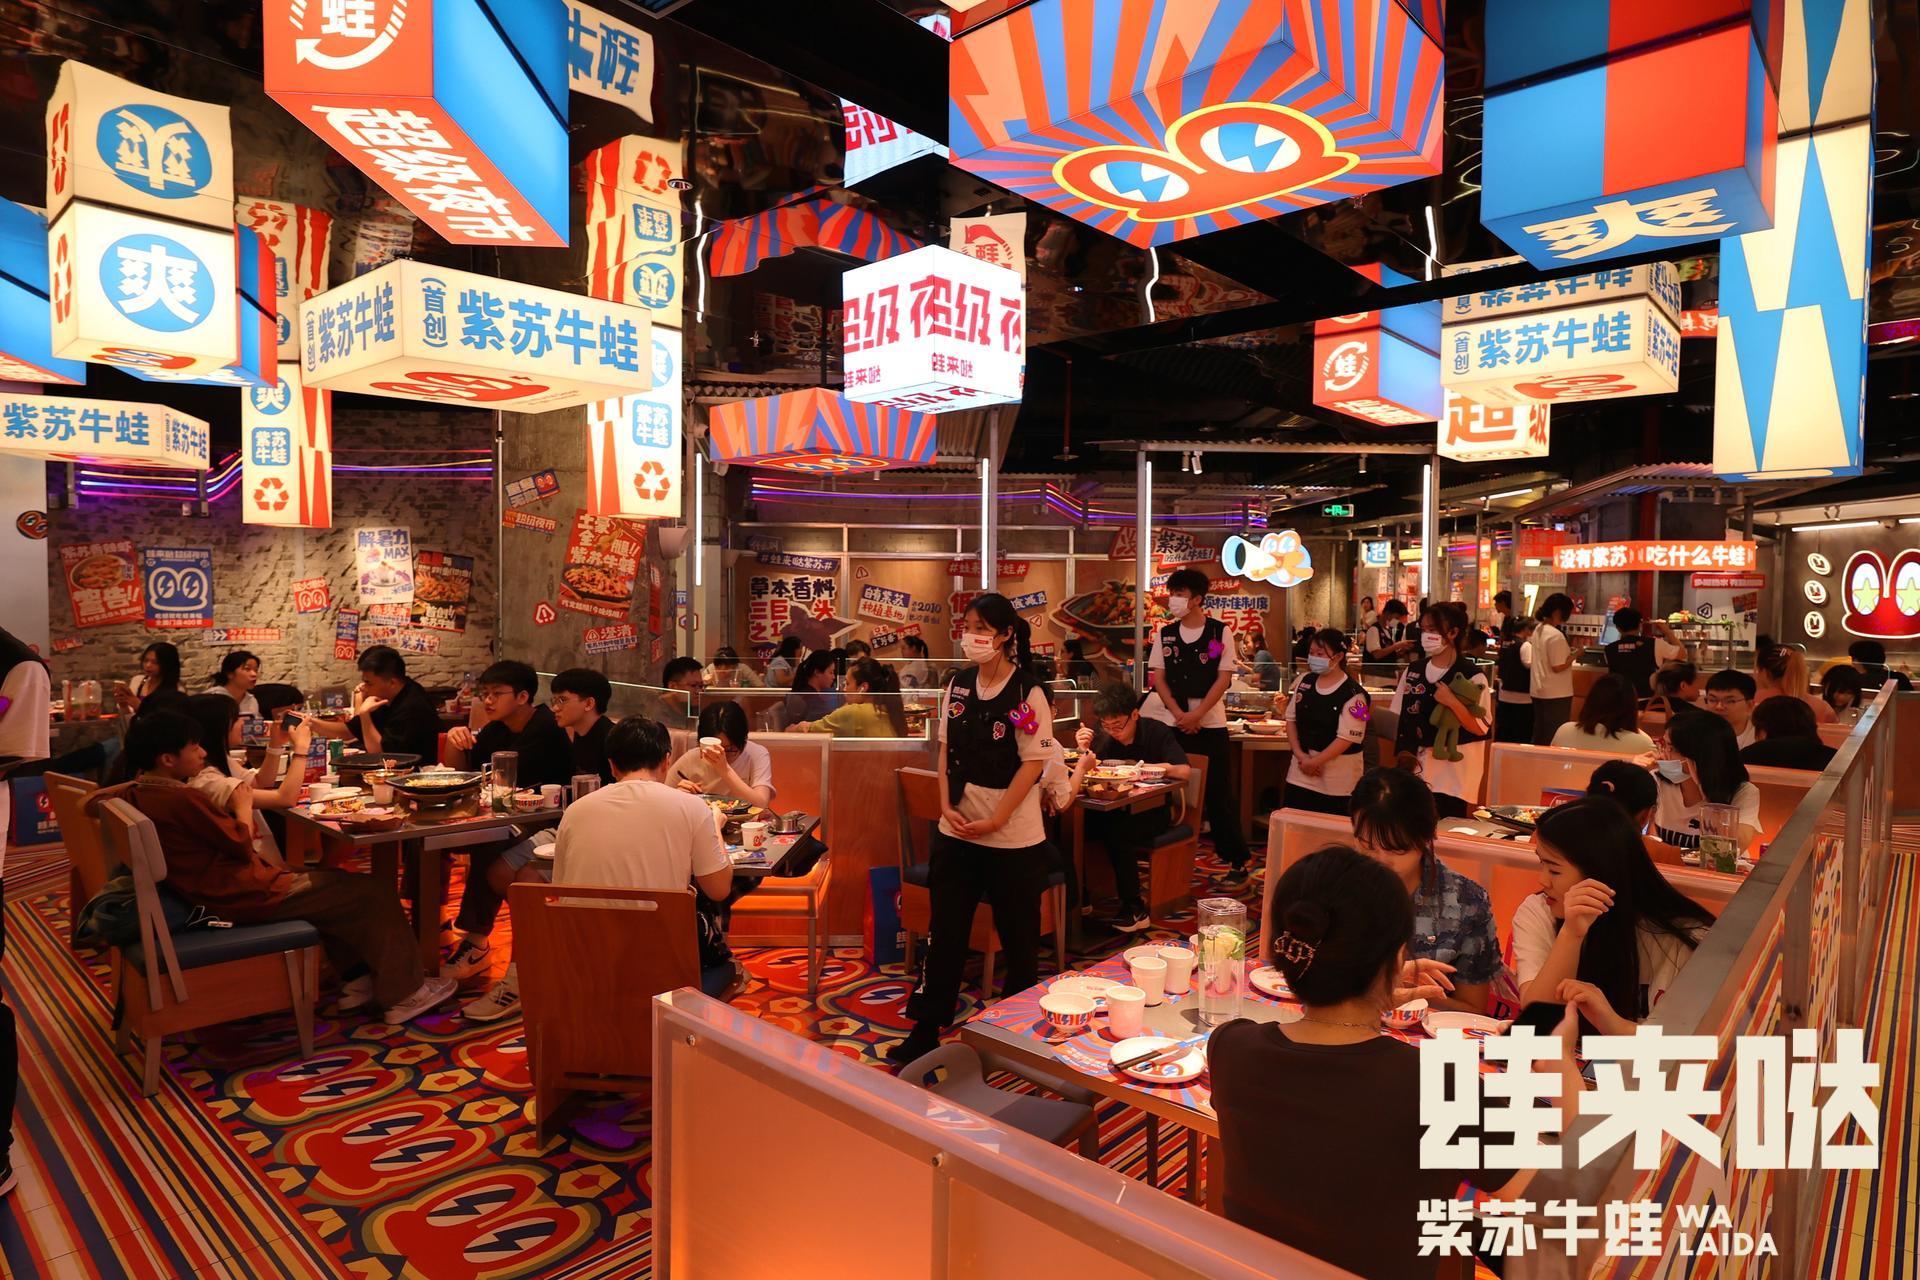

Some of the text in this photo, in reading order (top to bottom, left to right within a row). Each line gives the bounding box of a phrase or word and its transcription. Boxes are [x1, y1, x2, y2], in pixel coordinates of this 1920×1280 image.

[318, 281, 396, 364] 紫苏牛蛙
[457, 289, 640, 373] 紫苏牛蛙
[1477, 311, 1632, 369] 紫苏牛蛙
[1334, 354, 1357, 378] 蛙
[3, 402, 150, 446] 紫苏牛蛙
[358, 528, 409, 548] 解暑力
[1156, 531, 1193, 553] 紫苏
[384, 546, 410, 559] MAX
[570, 546, 638, 576] 紫苏牛蛙
[1560, 545, 1629, 568] 没有紫苏
[1645, 545, 1747, 567] 吃什么牛蛙
[750, 577, 836, 600] 草本香料
[861, 601, 906, 622] 种植基地
[917, 601, 942, 614] 2010
